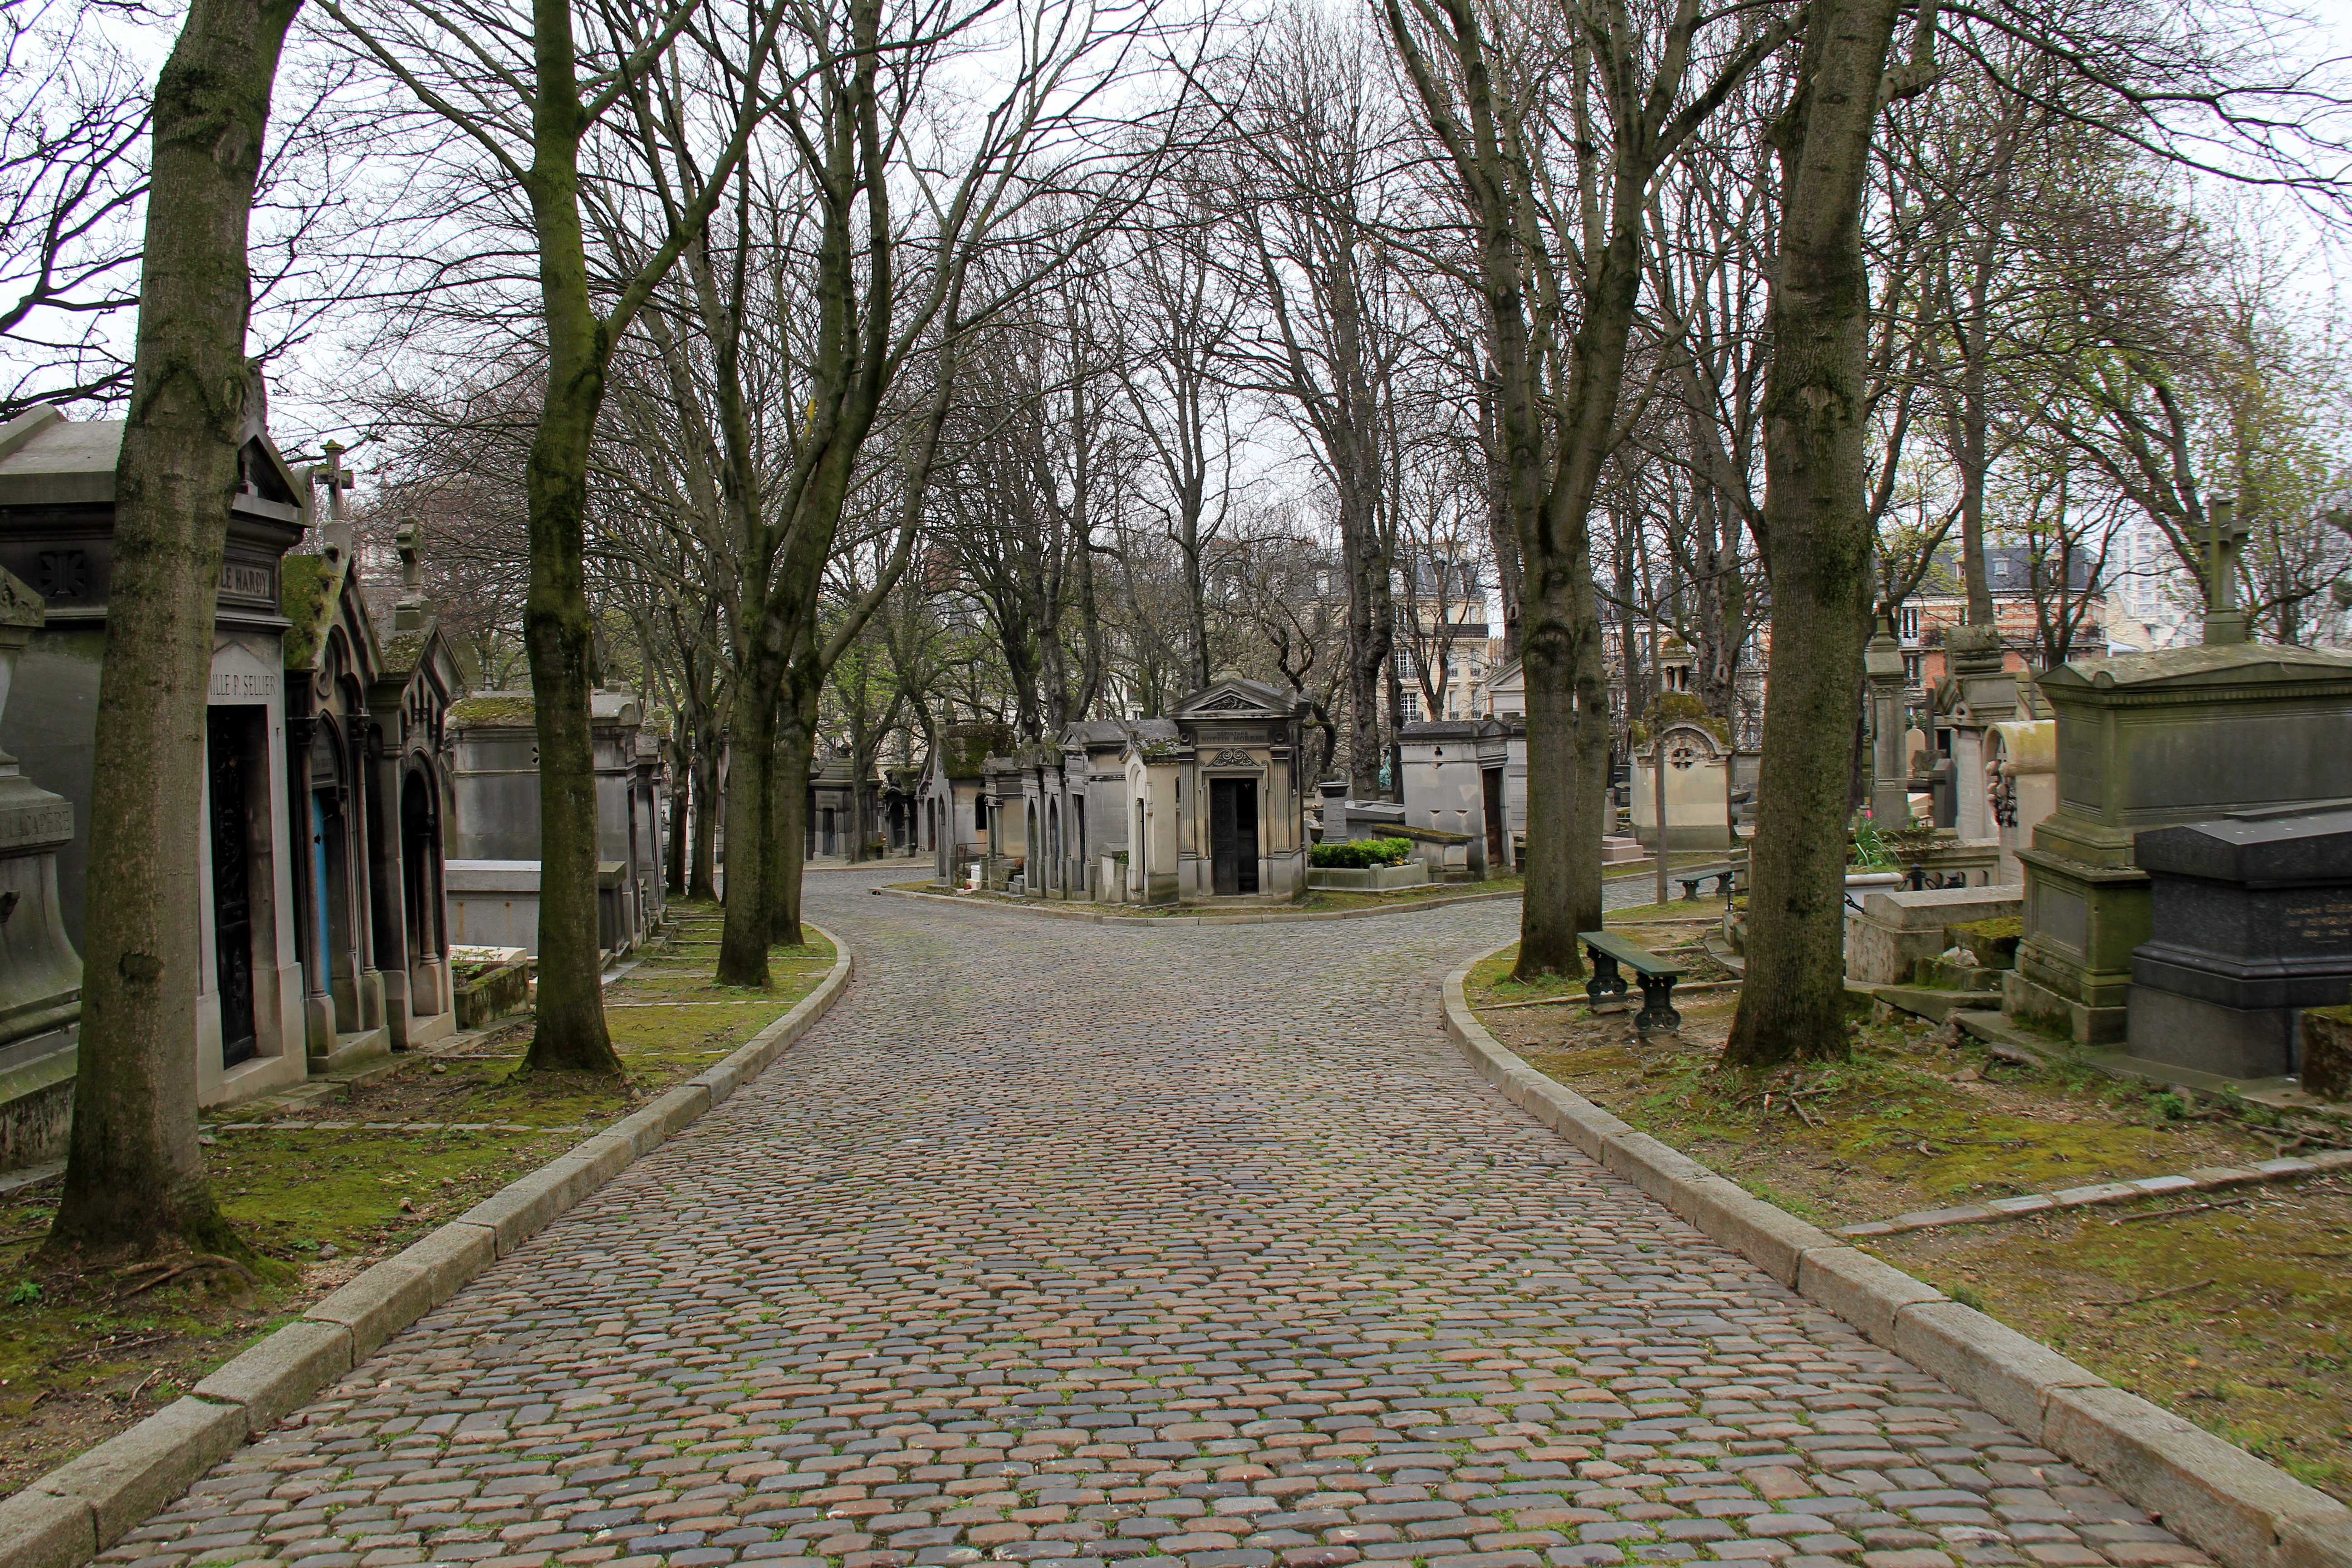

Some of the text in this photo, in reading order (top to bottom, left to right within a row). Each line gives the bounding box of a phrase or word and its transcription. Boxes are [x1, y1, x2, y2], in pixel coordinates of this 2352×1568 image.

[235, 568, 267, 594] HARDY
[234, 675, 241, 696] P.
[244, 675, 276, 696] SELLIER
